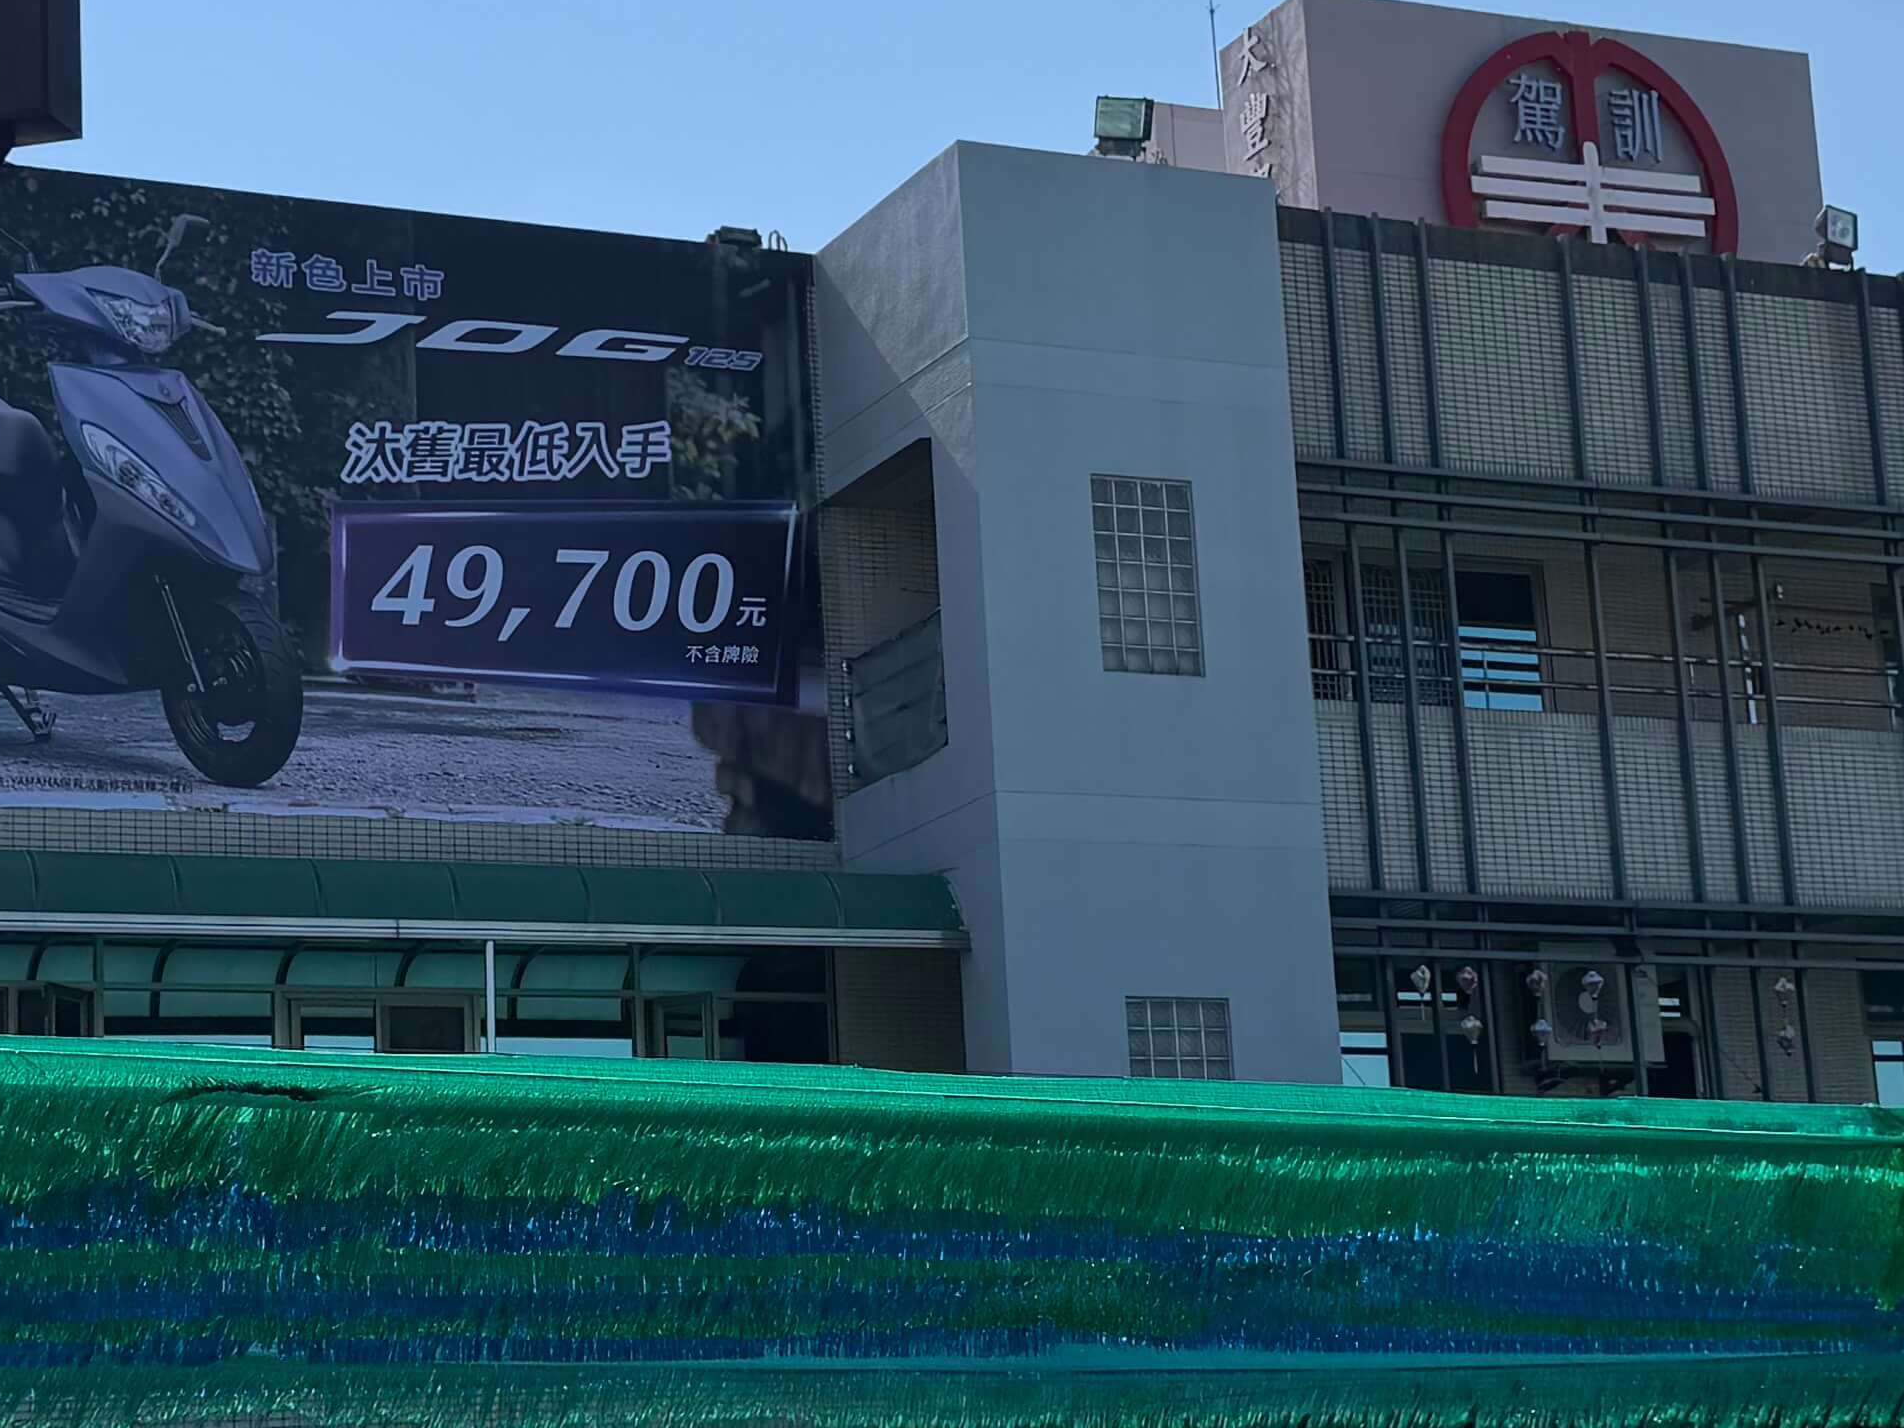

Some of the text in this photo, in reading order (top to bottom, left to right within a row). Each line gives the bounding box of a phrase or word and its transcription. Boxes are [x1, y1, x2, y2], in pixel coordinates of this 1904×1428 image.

[1237, 27, 1272, 179] 大豐
[1506, 73, 1666, 164] 駕訓
[251, 248, 446, 302] 新色上市
[255, 310, 764, 372] JOG 125
[340, 421, 673, 486] 汰舊最低入手
[684, 643, 761, 666] 不含牌險
